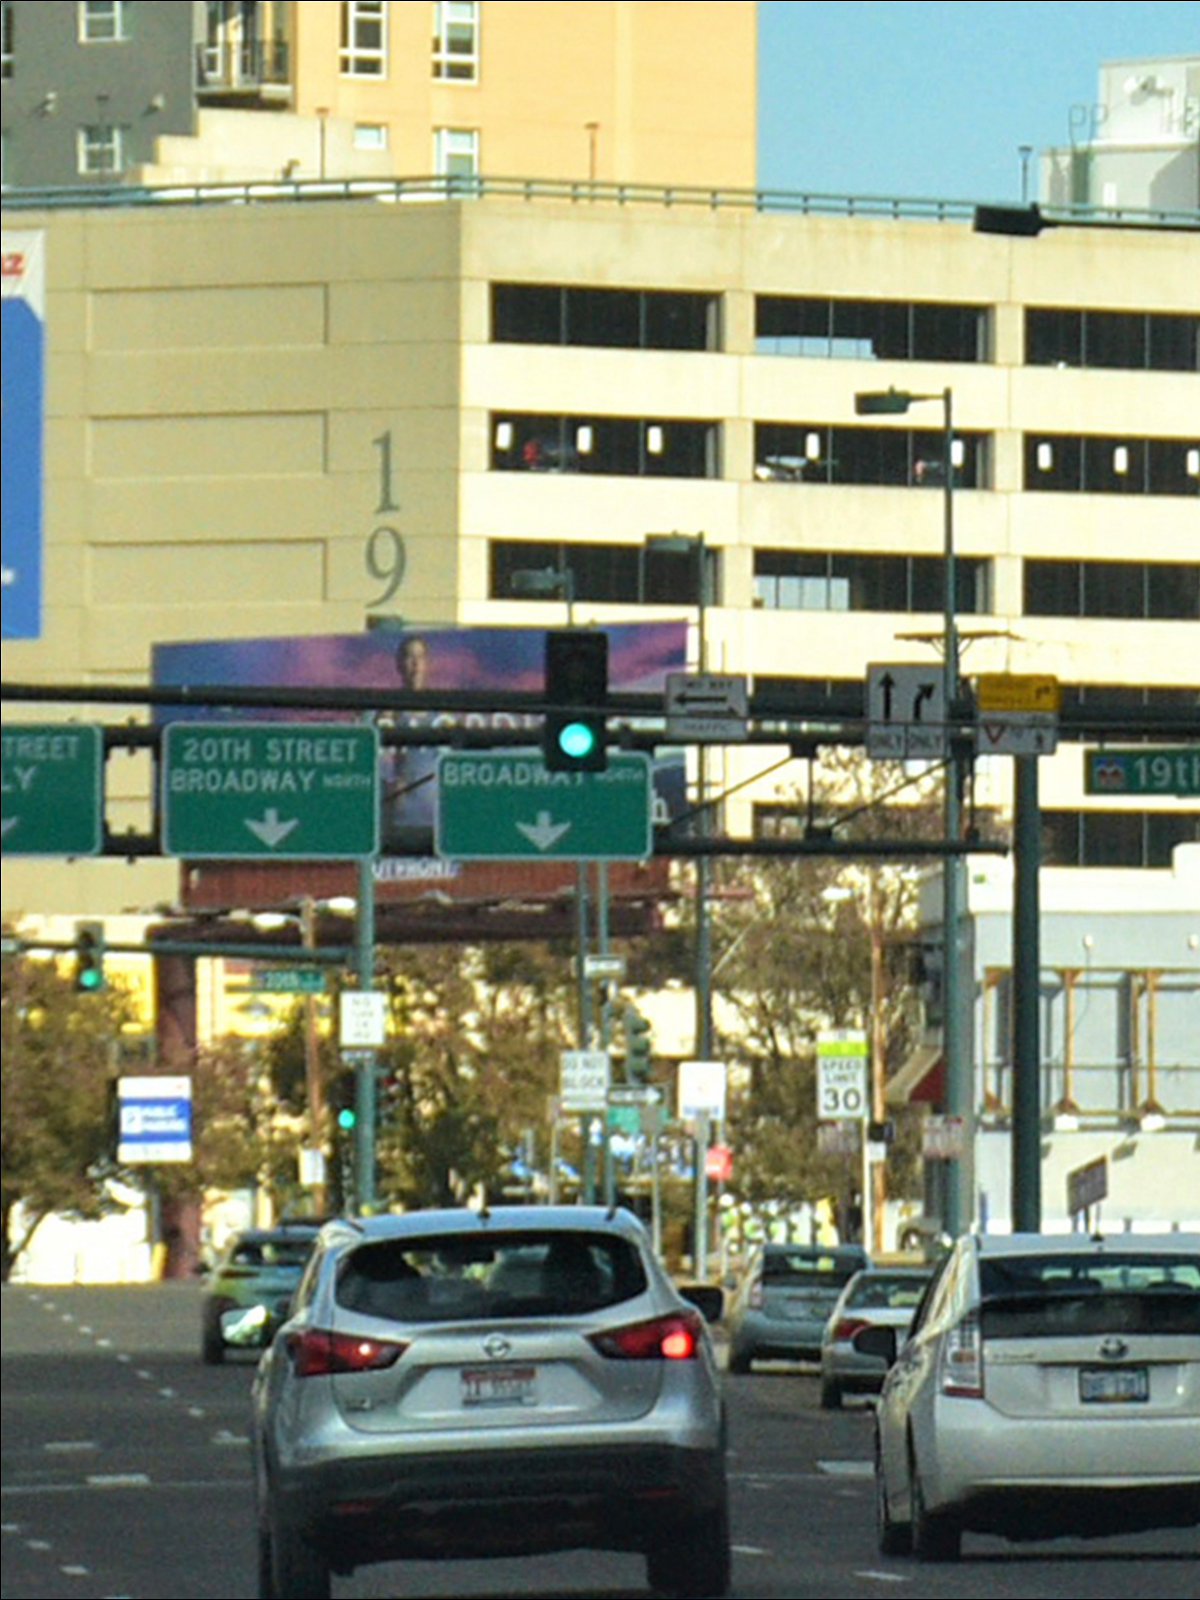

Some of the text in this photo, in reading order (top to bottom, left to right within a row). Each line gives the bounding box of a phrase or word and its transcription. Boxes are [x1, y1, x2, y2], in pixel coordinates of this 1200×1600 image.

[2, 736, 79, 760] TREET
[182, 738, 358, 762] 20TH STREET
[1, 767, 37, 792] LY
[170, 769, 316, 792] BROADWAY
[822, 1059, 862, 1071] SPEED
[823, 1087, 862, 1112] 30
